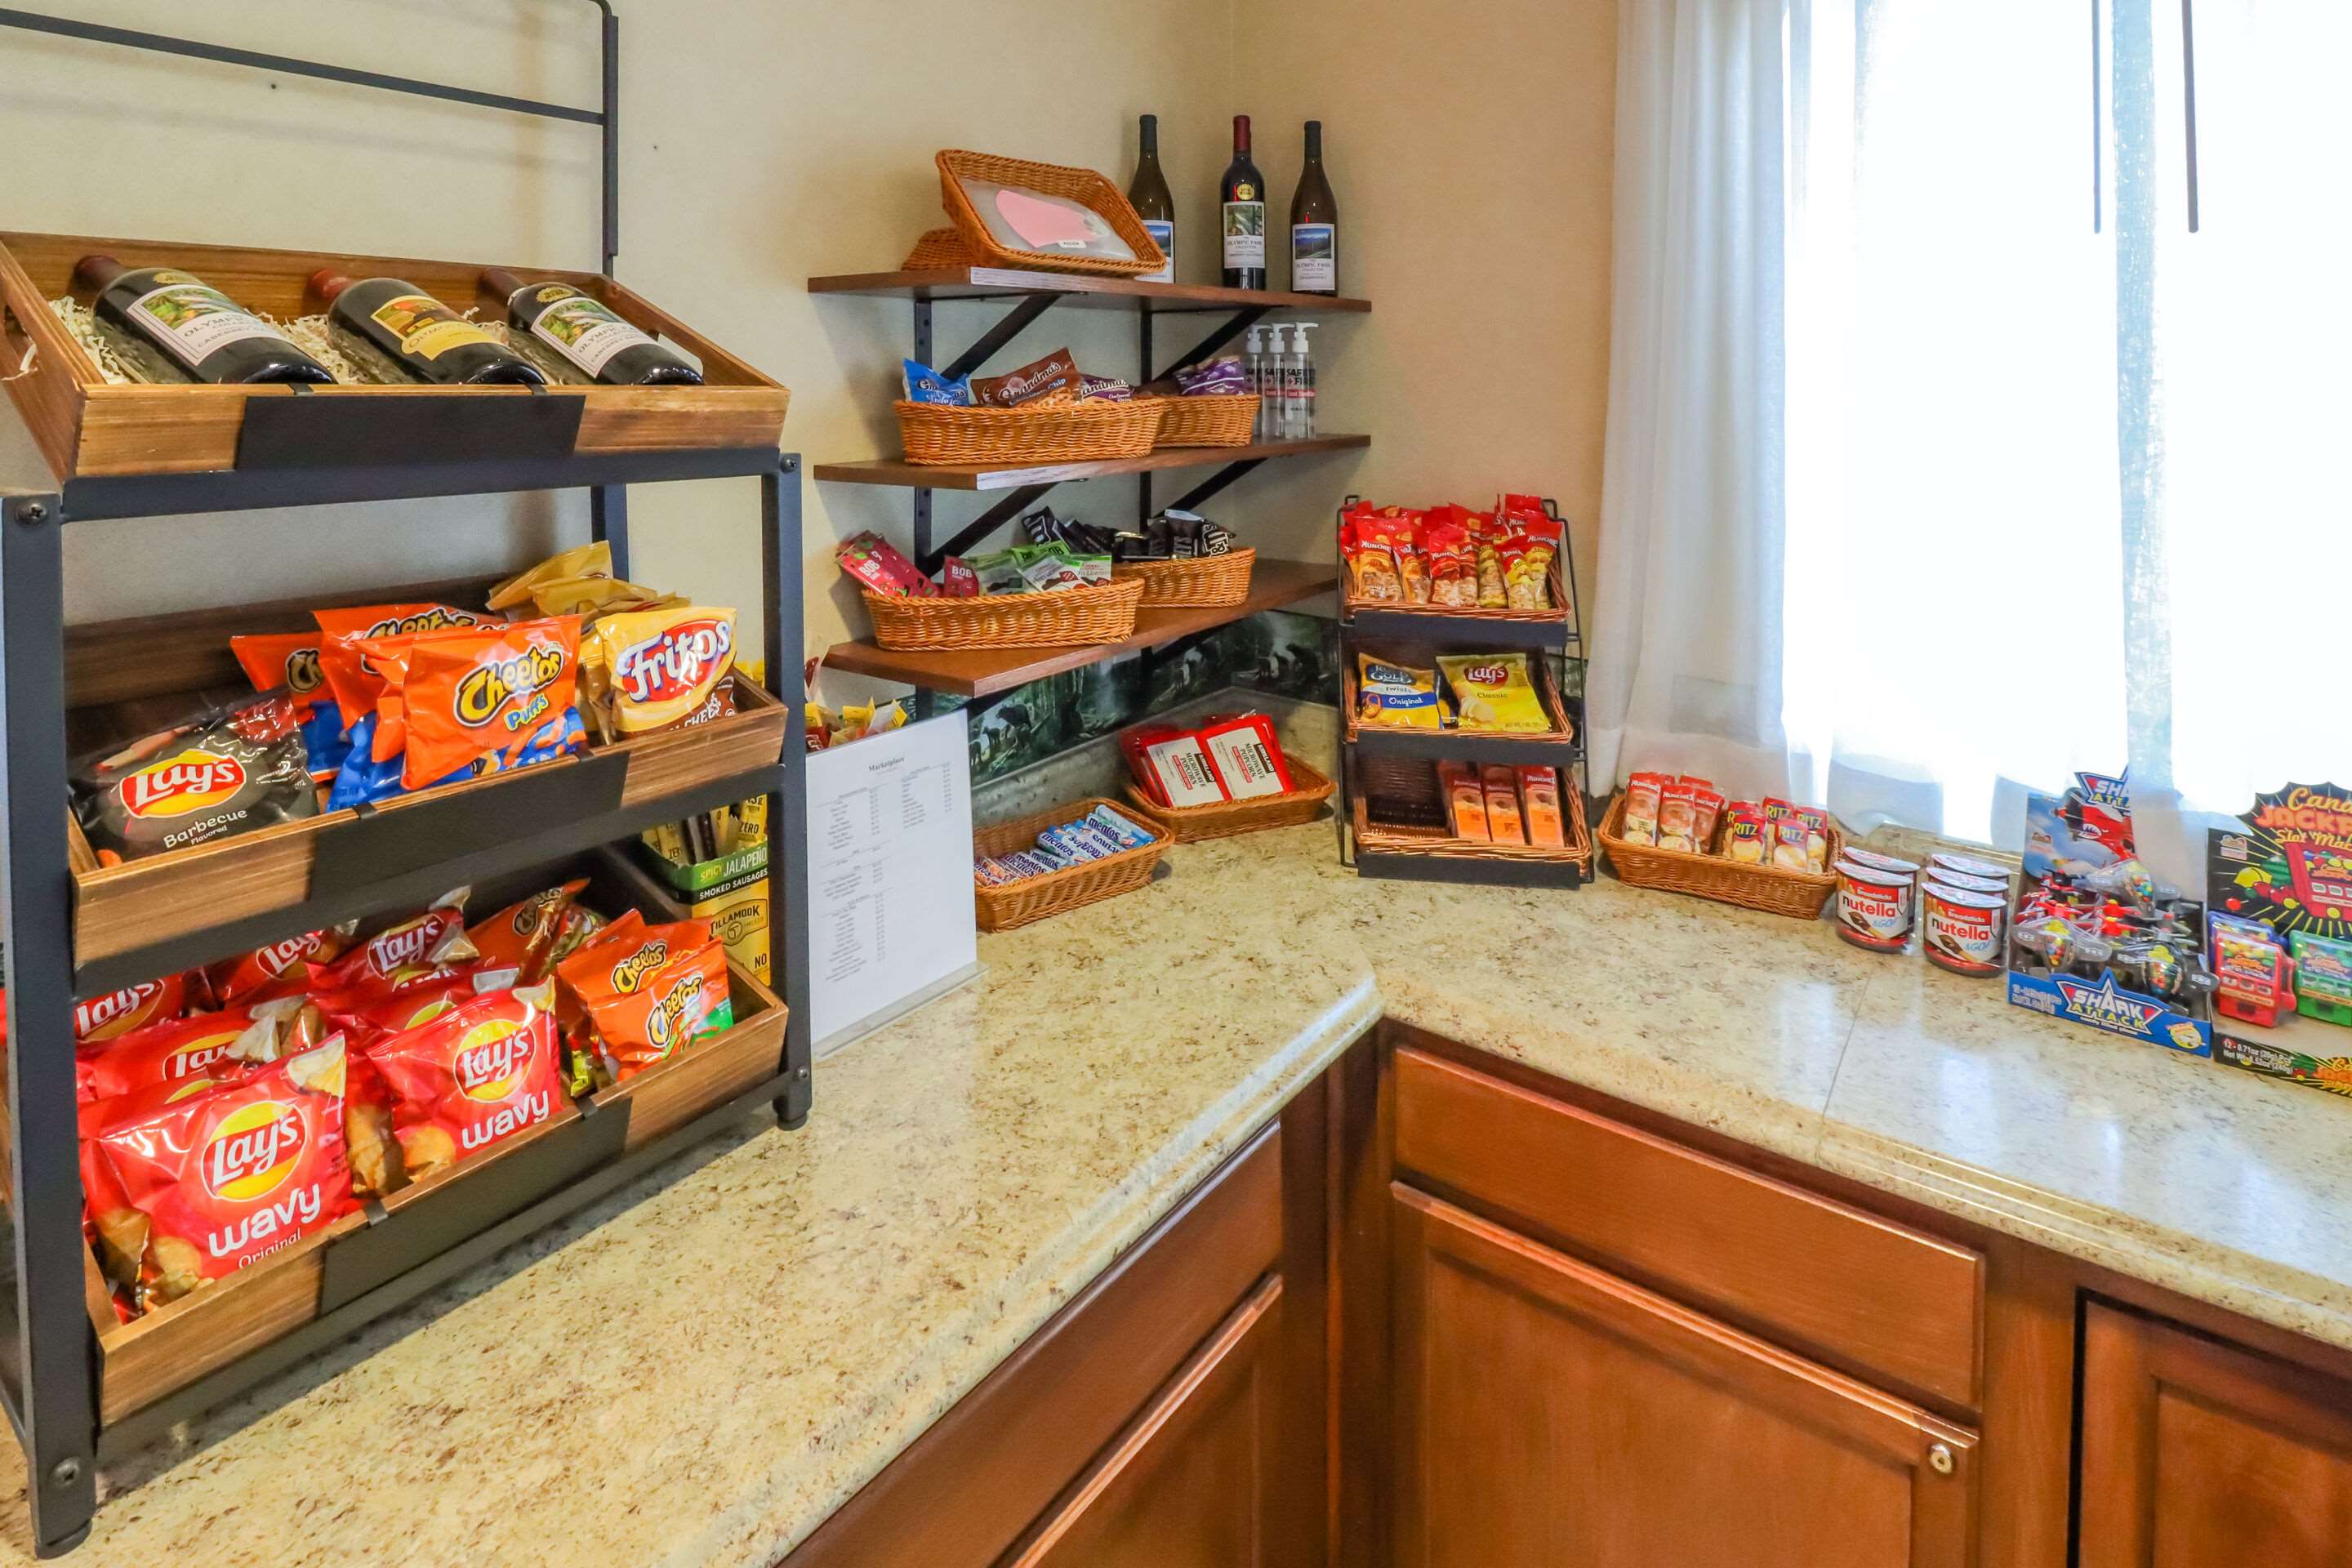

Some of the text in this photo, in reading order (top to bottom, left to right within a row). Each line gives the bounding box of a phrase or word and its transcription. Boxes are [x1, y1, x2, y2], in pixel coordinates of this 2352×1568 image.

[1082, 378, 1129, 396] andma's
[858, 559, 881, 577] BOB
[951, 564, 973, 579] BOB
[617, 621, 732, 702] Fritos
[1468, 666, 1506, 684] Lay's
[457, 647, 564, 725] Cheetos
[505, 693, 549, 731] Puffs
[1388, 697, 1424, 707] Original
[868, 755, 905, 773] Marketplace
[136, 761, 235, 807] Lay's
[1766, 804, 1793, 819] RITZ
[2287, 786, 2352, 815] Can
[163, 809, 248, 849] Barbecue
[738, 821, 760, 835] ZERO
[1089, 817, 1121, 840] mentos
[1734, 822, 1758, 835] RITZ
[1779, 826, 1805, 841] RITZ
[2254, 805, 2352, 837] JACKP
[190, 825, 228, 846] Flavored
[1042, 833, 1076, 857] mentos
[1032, 851, 1060, 870] mentos
[699, 867, 768, 901] SMOKED SAUSAGES
[710, 905, 760, 935] TILLAMOOK
[1842, 895, 1895, 917] nutella
[1931, 917, 1989, 941] nutella
[262, 929, 323, 974] Lay
[375, 920, 439, 973] Lay's
[613, 942, 666, 993] Cheetos
[755, 953, 768, 969] NO
[648, 975, 703, 1048] Cheetos
[2071, 1003, 2145, 1030] ATTACK
[2072, 987, 2143, 1021] SHARK
[463, 1030, 529, 1089] Lay's
[2223, 1049, 2236, 1059] Net
[461, 1090, 550, 1150] wavy
[213, 1116, 298, 1187] Lay's
[208, 1183, 321, 1258] wavy
[238, 1227, 301, 1269] Original
